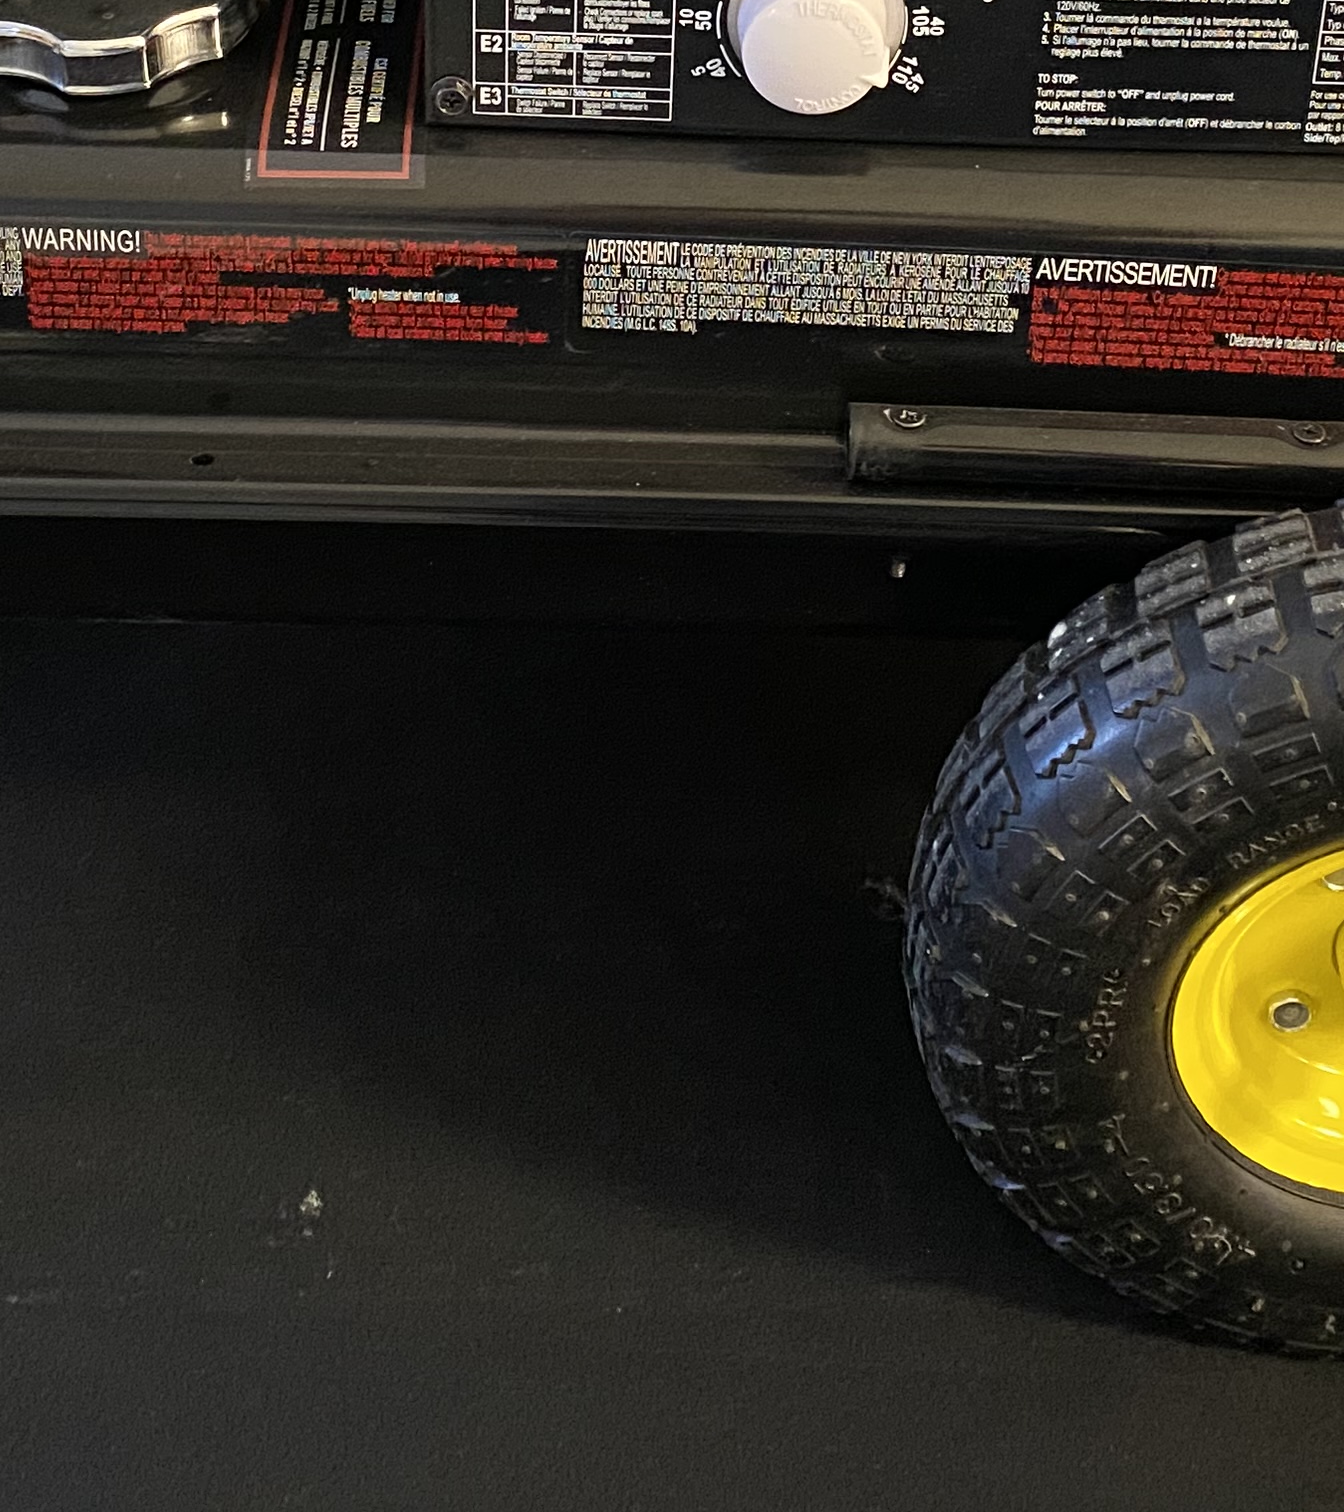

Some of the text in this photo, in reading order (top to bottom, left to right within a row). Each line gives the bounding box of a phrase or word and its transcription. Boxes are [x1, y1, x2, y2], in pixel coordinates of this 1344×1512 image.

[679, 9, 694, 27] 10
[695, 10, 712, 31] 50
[912, 5, 929, 37] 105
[930, 16, 944, 36] 40
[480, 35, 503, 53] E2
[691, 65, 706, 76] 5
[707, 58, 726, 78] 40
[891, 56, 918, 85] 110
[905, 72, 924, 93] 45
[1038, 74, 1079, 84] TO STOP:
[479, 87, 502, 105] E3
[1037, 88, 1054, 98] Turn
[1056, 90, 1080, 100] power
[1081, 89, 1106, 99] switch
[1108, 90, 1115, 99] to
[1145, 91, 1160, 100] and
[1162, 92, 1189, 102] unplug
[1190, 93, 1214, 102] power
[1216, 92, 1235, 102] cord.
[366, 102, 382, 122] POUR
[1035, 101, 1060, 111] POUR
[340, 96, 362, 148] MULTIPLES
[22, 227, 141, 253] WARNING!
[585, 239, 680, 265] AVERTISSEMENT
[1035, 258, 1218, 288] AVERTISSEMENT!
[378, 288, 402, 301] heater
[403, 289, 422, 302] when
